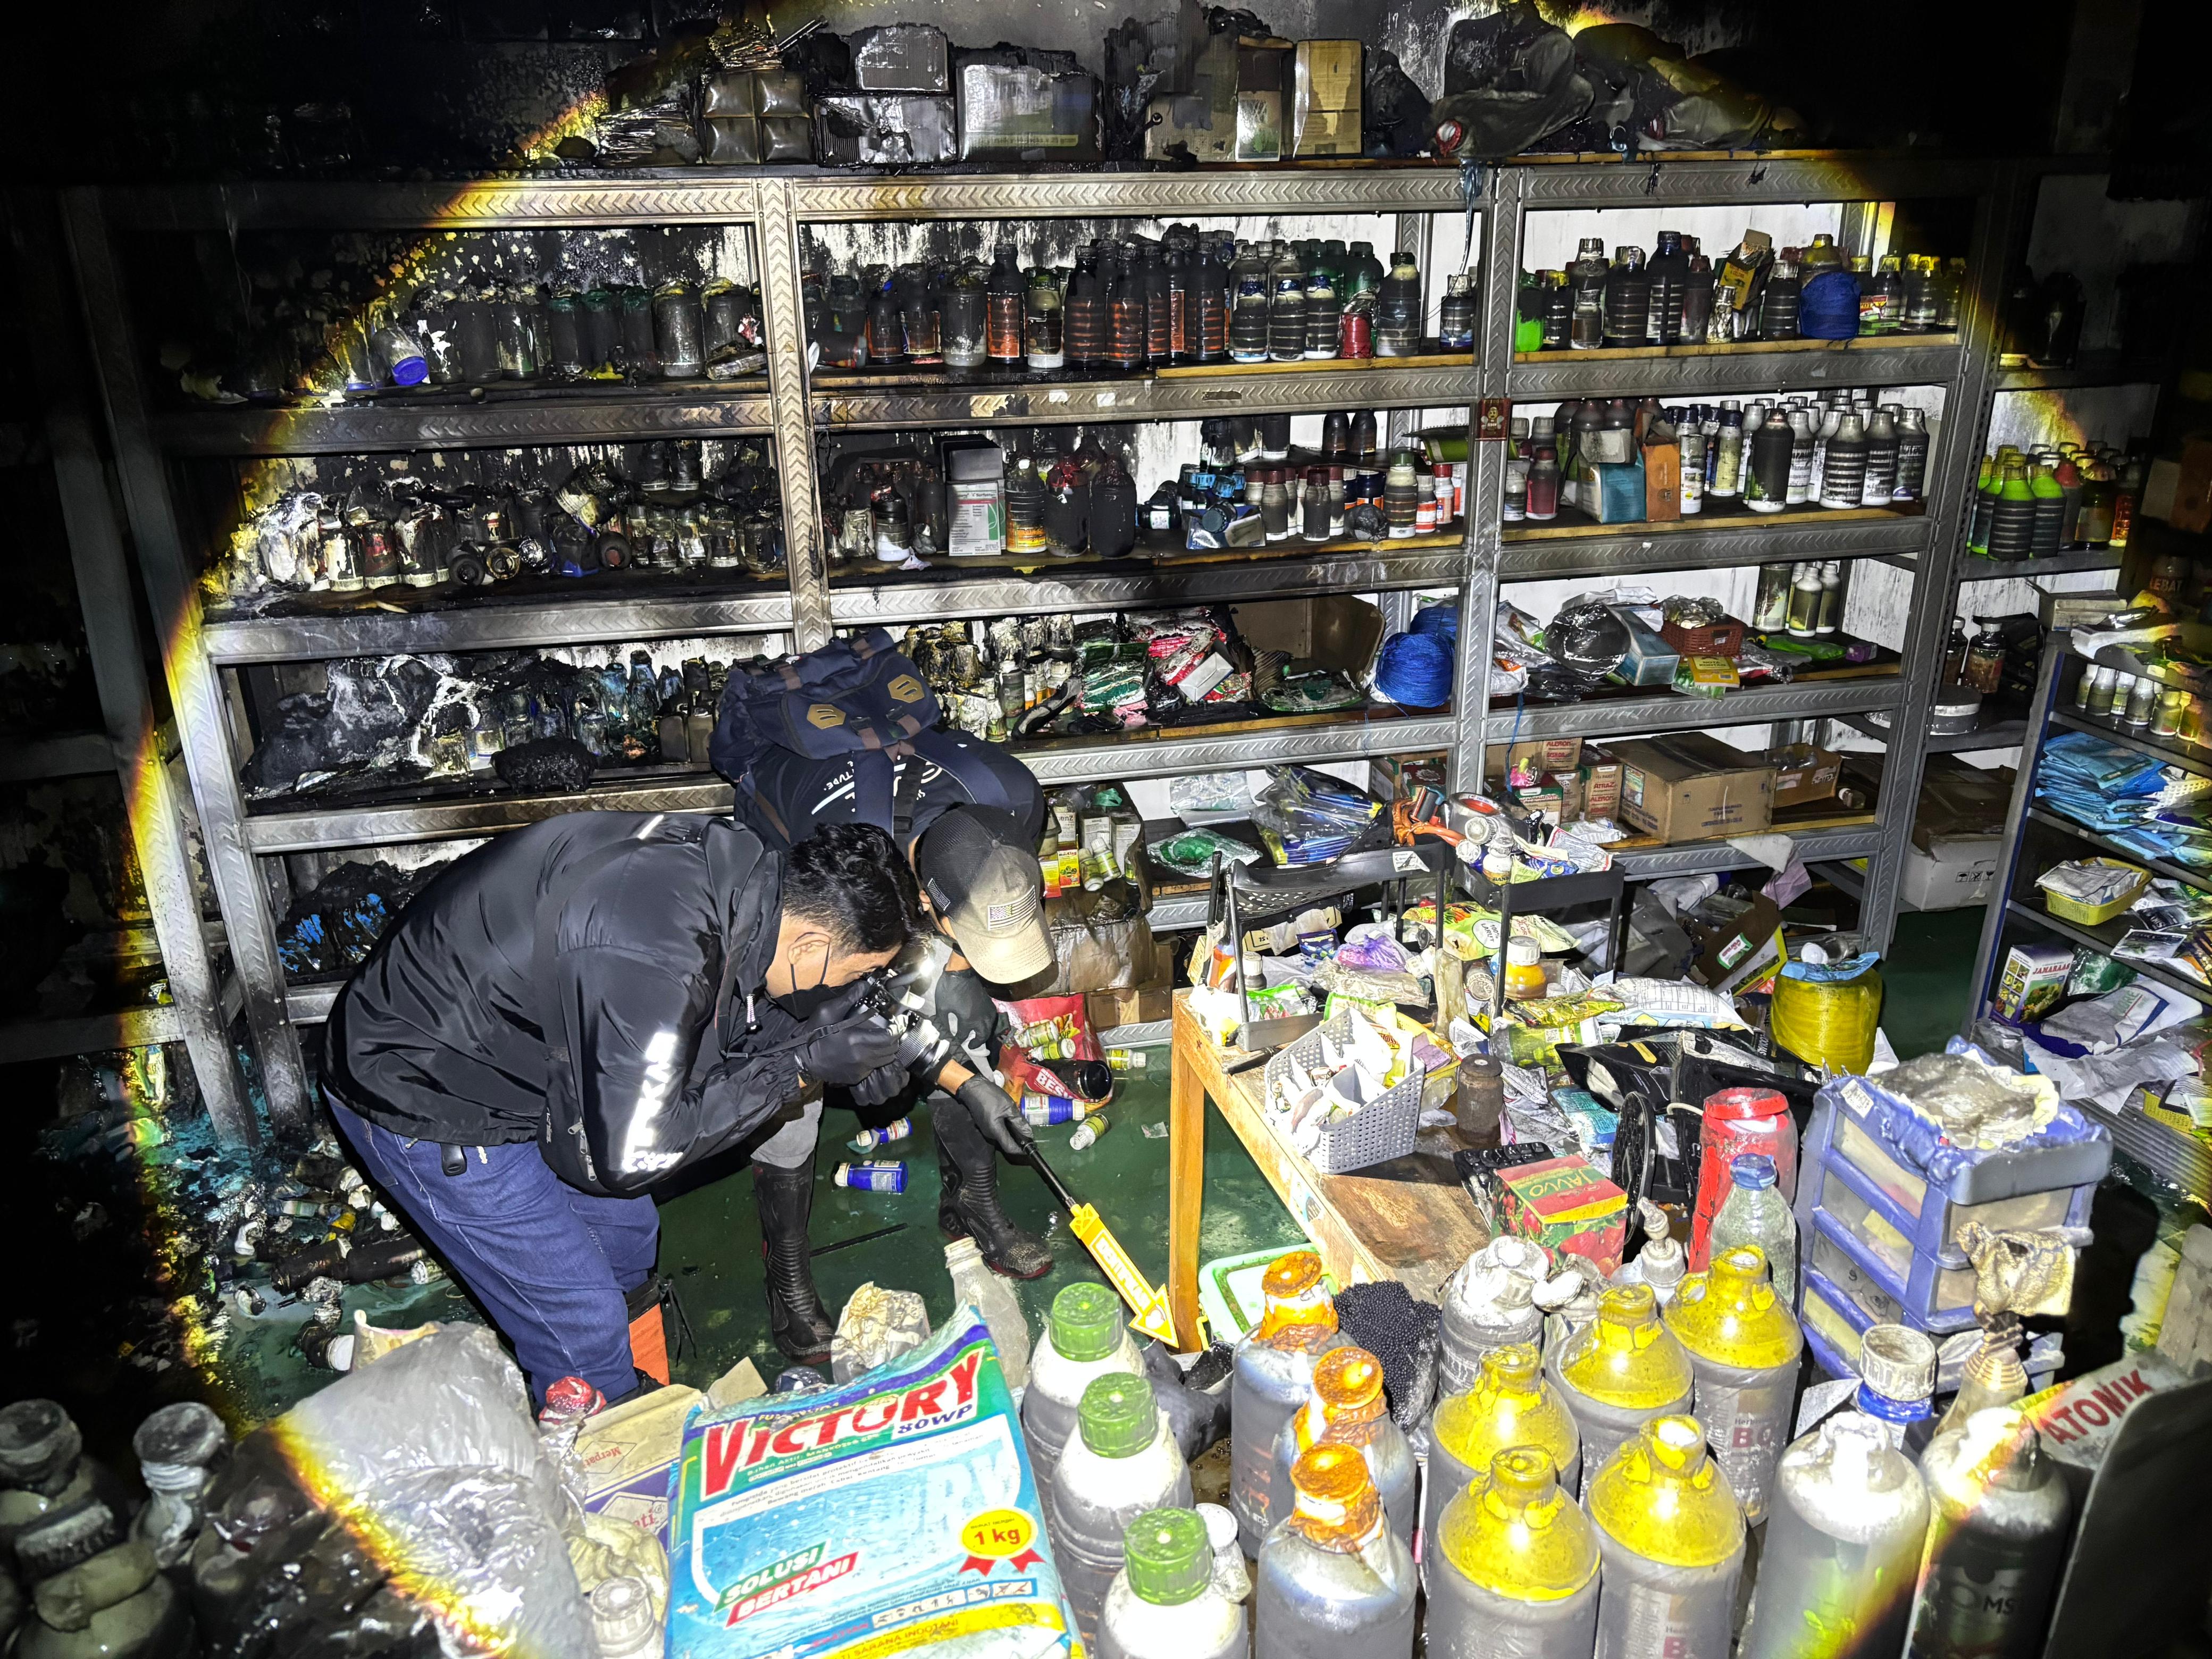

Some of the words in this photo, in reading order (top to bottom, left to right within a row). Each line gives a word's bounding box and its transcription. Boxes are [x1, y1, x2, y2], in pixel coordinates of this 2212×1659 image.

[1528, 1169, 1593, 1197] JAVVO
[706, 1352, 977, 1497] VICTORY
[898, 1404, 973, 1434] 80WP
[2042, 1370, 2156, 1446] ATONIK
[974, 1531, 985, 1545] 1
[992, 1528, 1021, 1545] kg
[724, 1547, 819, 1604] SOLUSI
[736, 1557, 851, 1621] BERTANI
